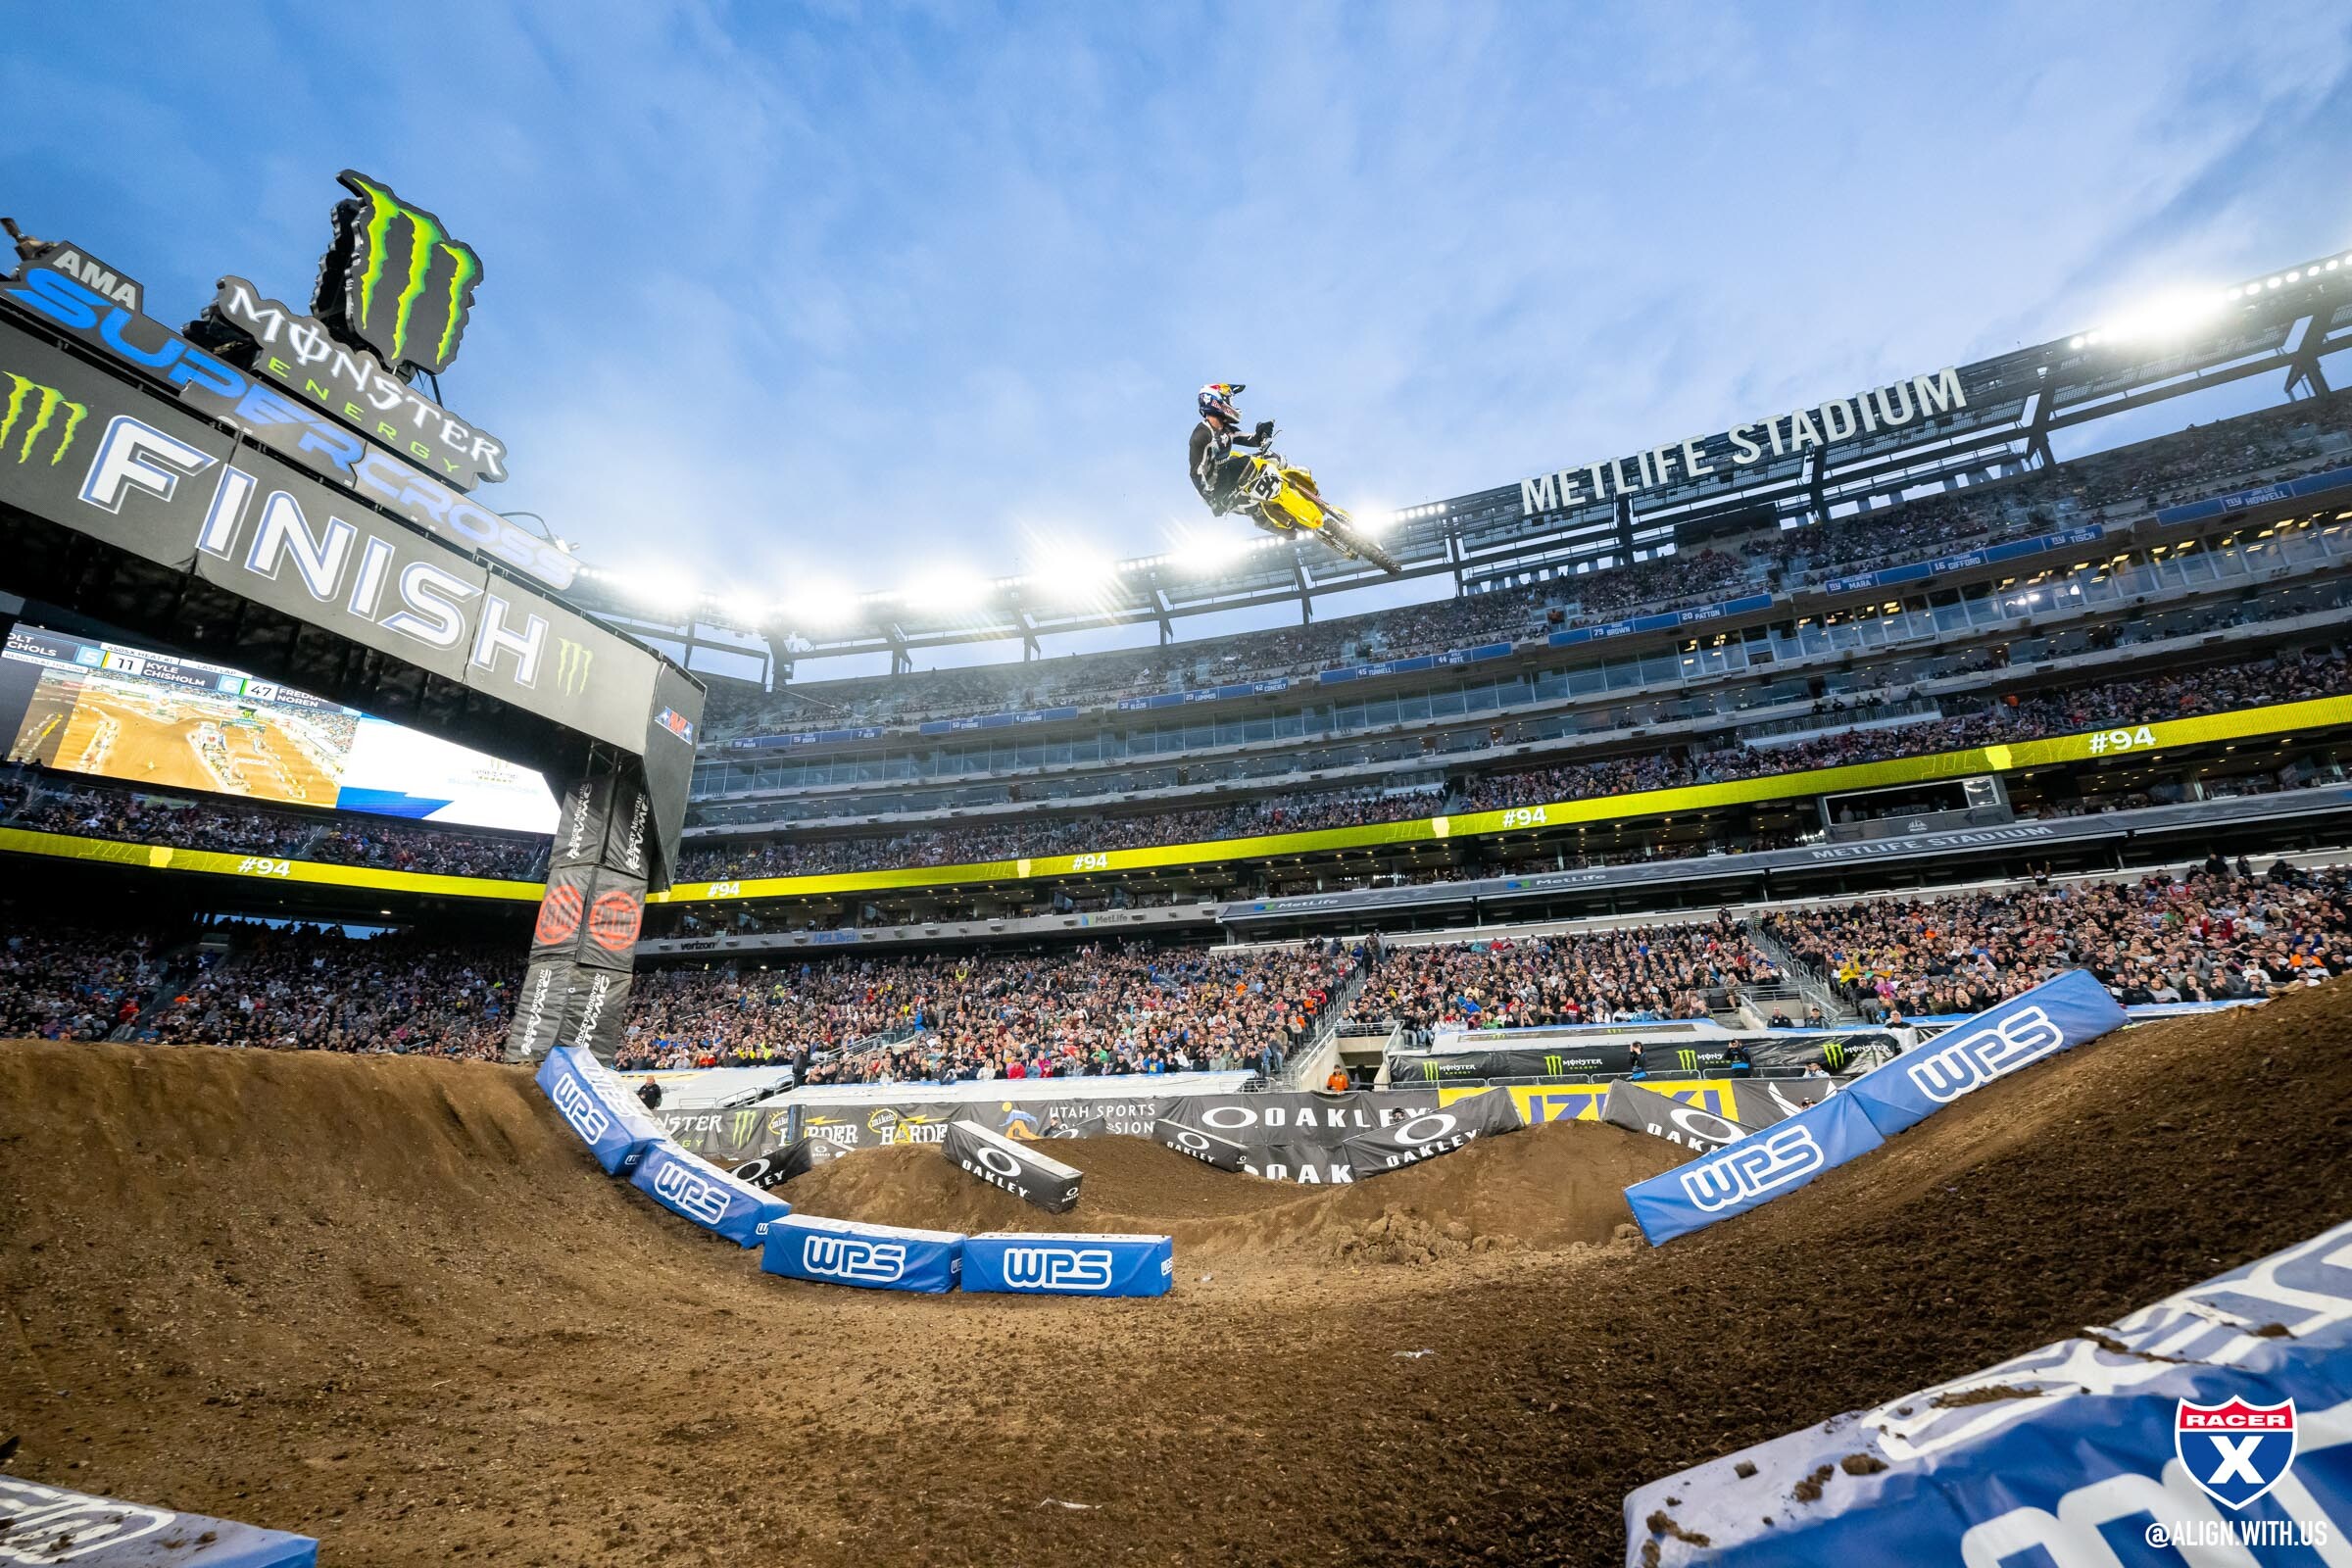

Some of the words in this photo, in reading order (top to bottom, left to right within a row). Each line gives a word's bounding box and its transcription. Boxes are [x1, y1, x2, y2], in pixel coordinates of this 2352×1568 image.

[52, 249, 137, 311] AMA
[226, 285, 505, 478] MONSTER
[268, 356, 462, 473] ENERGY
[8, 268, 576, 590] SUPERCROSS
[1519, 434, 1715, 516] METLIFE
[1727, 365, 1968, 466] STADIUM
[2244, 491, 2288, 506] HOWELL
[2070, 532, 2096, 543] TISCH
[79, 414, 549, 690] FINISH
[1948, 558, 1981, 570] GIFFORD
[1848, 580, 1871, 589] MARA
[1694, 610, 1721, 620] PATTON
[1606, 626, 1631, 636] BROWN
[108, 646, 136, 656] 450SX
[137, 652, 162, 661] HEAT
[118, 658, 134, 670] 11
[146, 662, 179, 674] KYLE
[143, 668, 205, 687] CHISHOLM
[251, 685, 272, 697] 47
[276, 695, 319, 708] NOREN
[2088, 727, 2156, 755] #94
[1501, 807, 1547, 829] #94
[1812, 840, 1923, 859] METLIFE
[1927, 826, 2055, 847] STADIUM
[237, 857, 291, 877] #94
[1072, 853, 1107, 871] #94
[1536, 874, 1607, 885] MetLife
[707, 882, 740, 898] #94
[1278, 898, 1339, 908] MetLife
[1095, 914, 1128, 924] MetLife
[680, 940, 716, 951] verizon
[530, 969, 545, 1014] MOUNTAIN
[574, 1018, 589, 1045] ROCKY
[584, 972, 602, 1016] MOUNTAIN
[1696, 1053, 1726, 1061] MONS
[1843, 1044, 1890, 1054] MONSTER
[1906, 1005, 2064, 1103] WPS
[1439, 1063, 1477, 1072] MONSTER
[1562, 1058, 1603, 1067] MONSTER
[553, 1073, 610, 1146] WPS
[1050, 1105, 1089, 1118] UTAH
[1097, 1103, 1155, 1117] SPORTS
[656, 1112, 722, 1136] NSTER
[880, 1123, 948, 1147] HARDE
[1167, 1140, 1216, 1163] OAKLEY
[1386, 1129, 1478, 1168] OAKLEY
[1679, 1124, 1825, 1213] WPS
[961, 1159, 1029, 1198] OAKLEY
[654, 1161, 732, 1225] WPS
[804, 1235, 906, 1283] WPS
[1004, 1249, 1112, 1291] WPS
